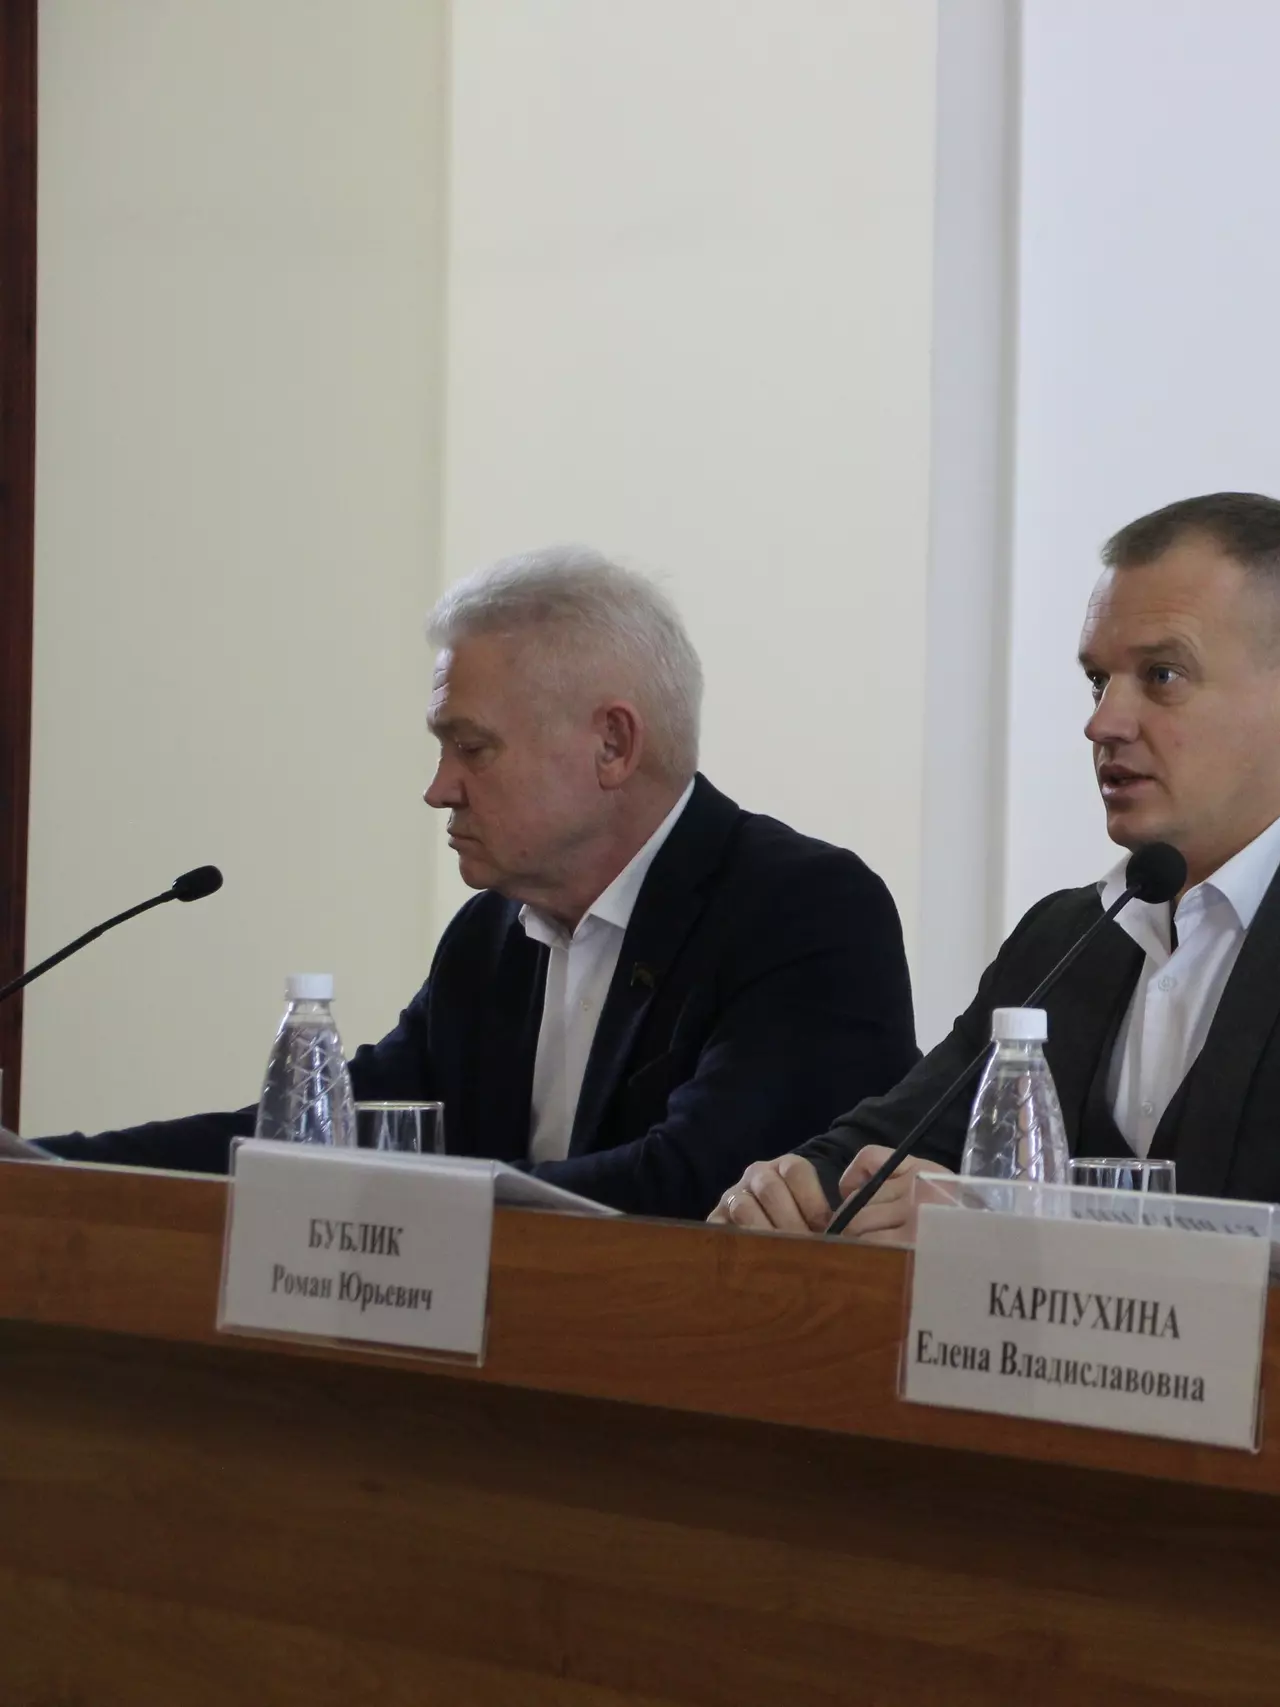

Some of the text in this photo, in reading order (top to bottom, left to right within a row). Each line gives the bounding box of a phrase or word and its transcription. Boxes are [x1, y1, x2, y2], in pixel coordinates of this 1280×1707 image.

[308, 1218, 404, 1257] БУБЛИК
[271, 1264, 433, 1312] Роман Юрьевич
[988, 1281, 1181, 1339] КАРПУХИНА
[914, 1330, 1206, 1403] Елена Владиславовна
